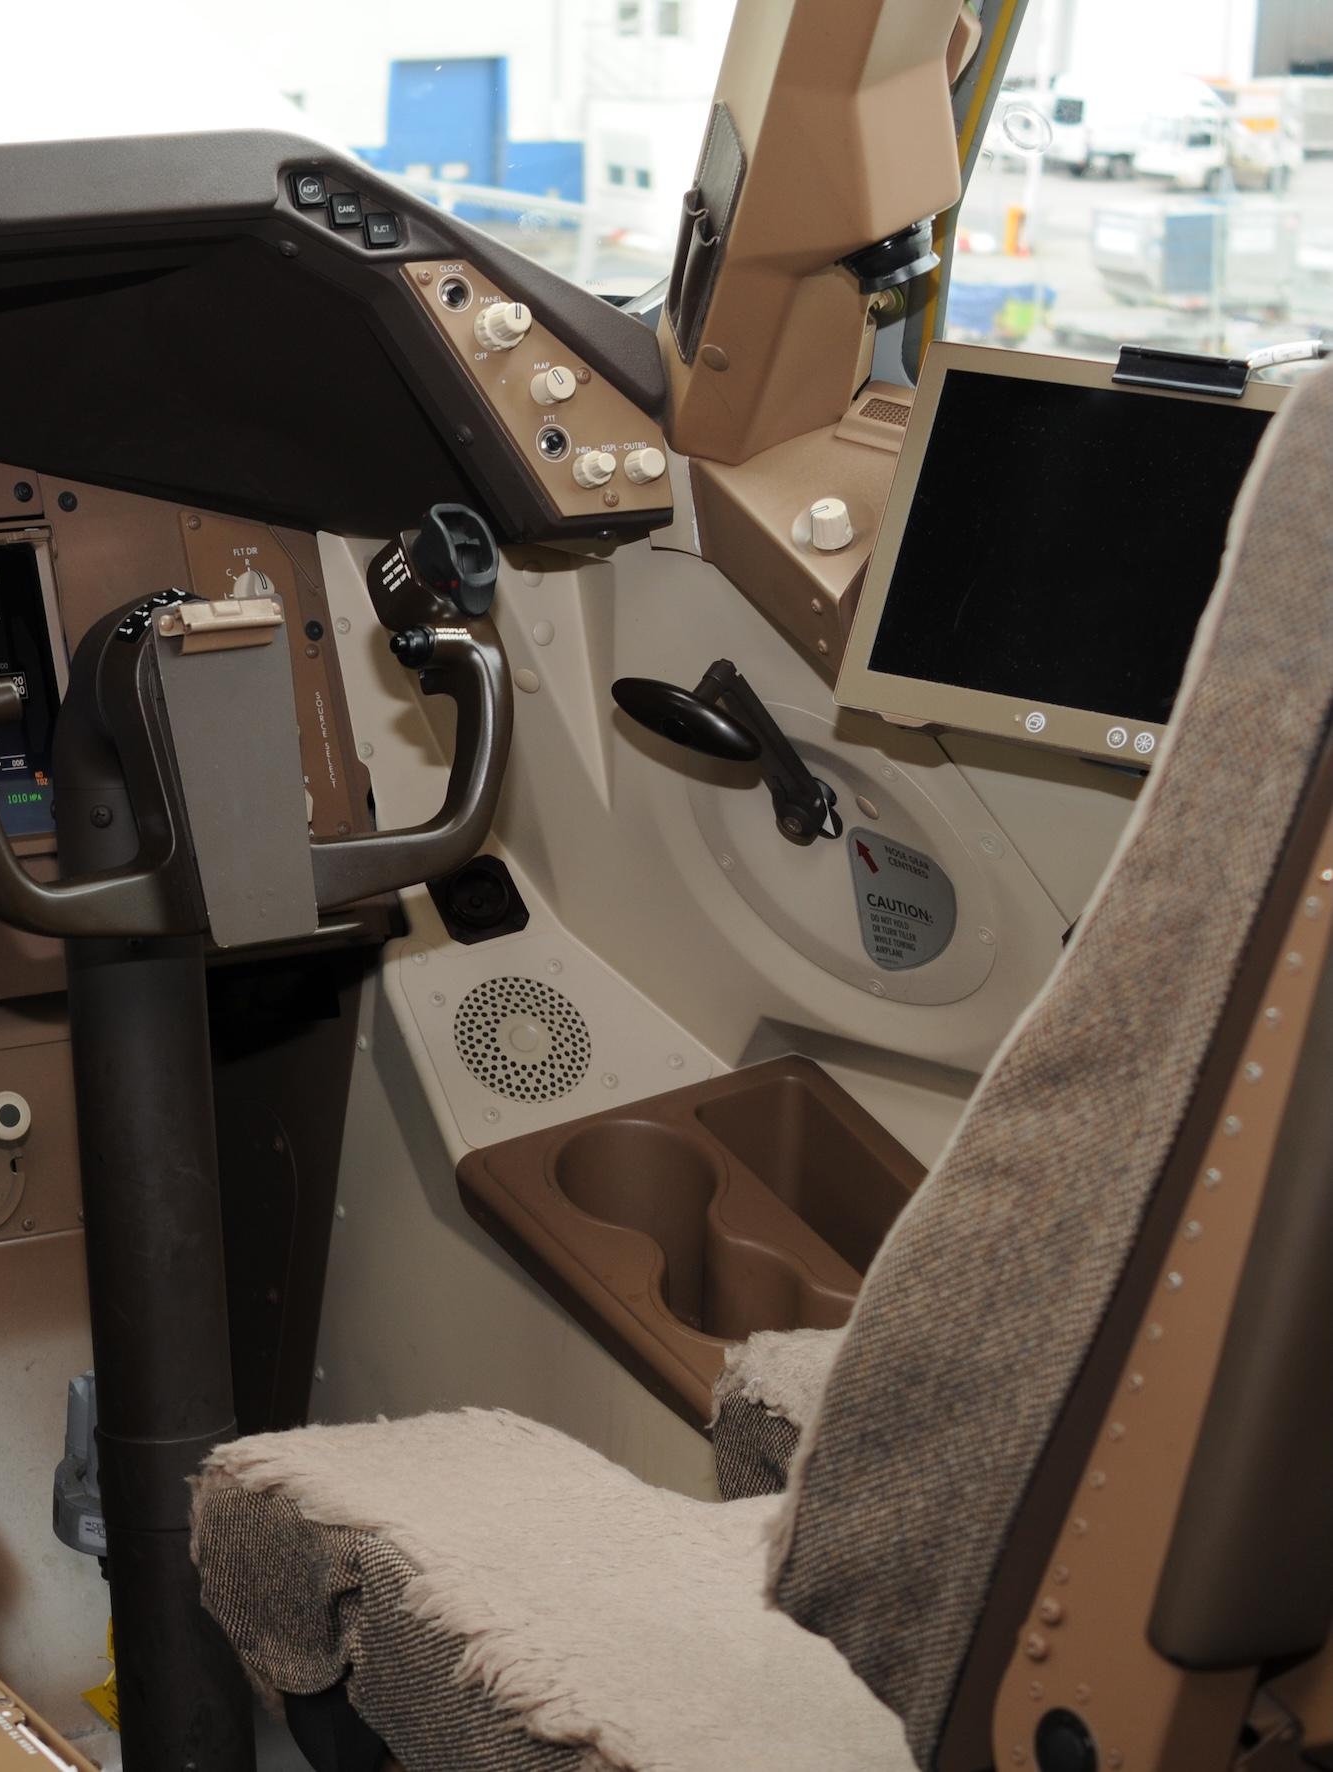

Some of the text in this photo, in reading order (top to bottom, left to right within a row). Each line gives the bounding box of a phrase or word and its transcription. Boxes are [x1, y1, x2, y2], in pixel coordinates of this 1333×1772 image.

[303, 185, 318, 194] ACPT
[338, 205, 355, 213] CANC
[374, 225, 390, 233] RJCT
[439, 264, 464, 273] CLOCK
[480, 296, 502, 304] PANEL
[475, 352, 488, 361] OFF
[534, 362, 550, 371] MAP
[233, 547, 258, 556] FLT DIR
[8, 794, 28, 805] 1010
